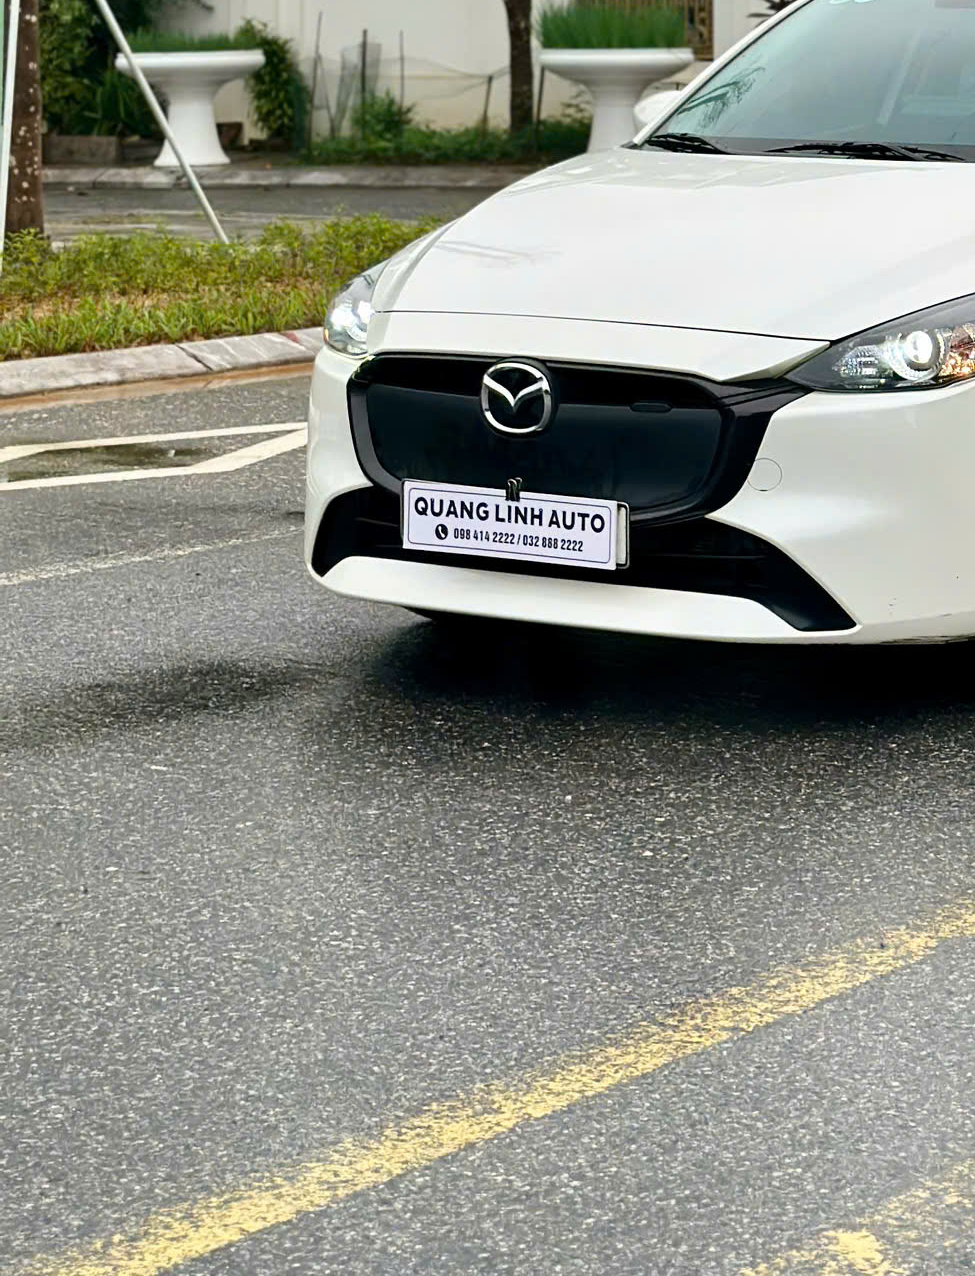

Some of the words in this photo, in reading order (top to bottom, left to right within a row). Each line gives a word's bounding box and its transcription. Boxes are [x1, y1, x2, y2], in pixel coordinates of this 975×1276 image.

[415, 496, 489, 521] QUANG
[495, 504, 543, 527] LINH
[548, 509, 605, 533] AUTO
[453, 527, 471, 540] 098
[473, 529, 490, 542] 414
[492, 531, 515, 545] 2222
[522, 534, 540, 547] 032
[560, 538, 584, 552] 2222
